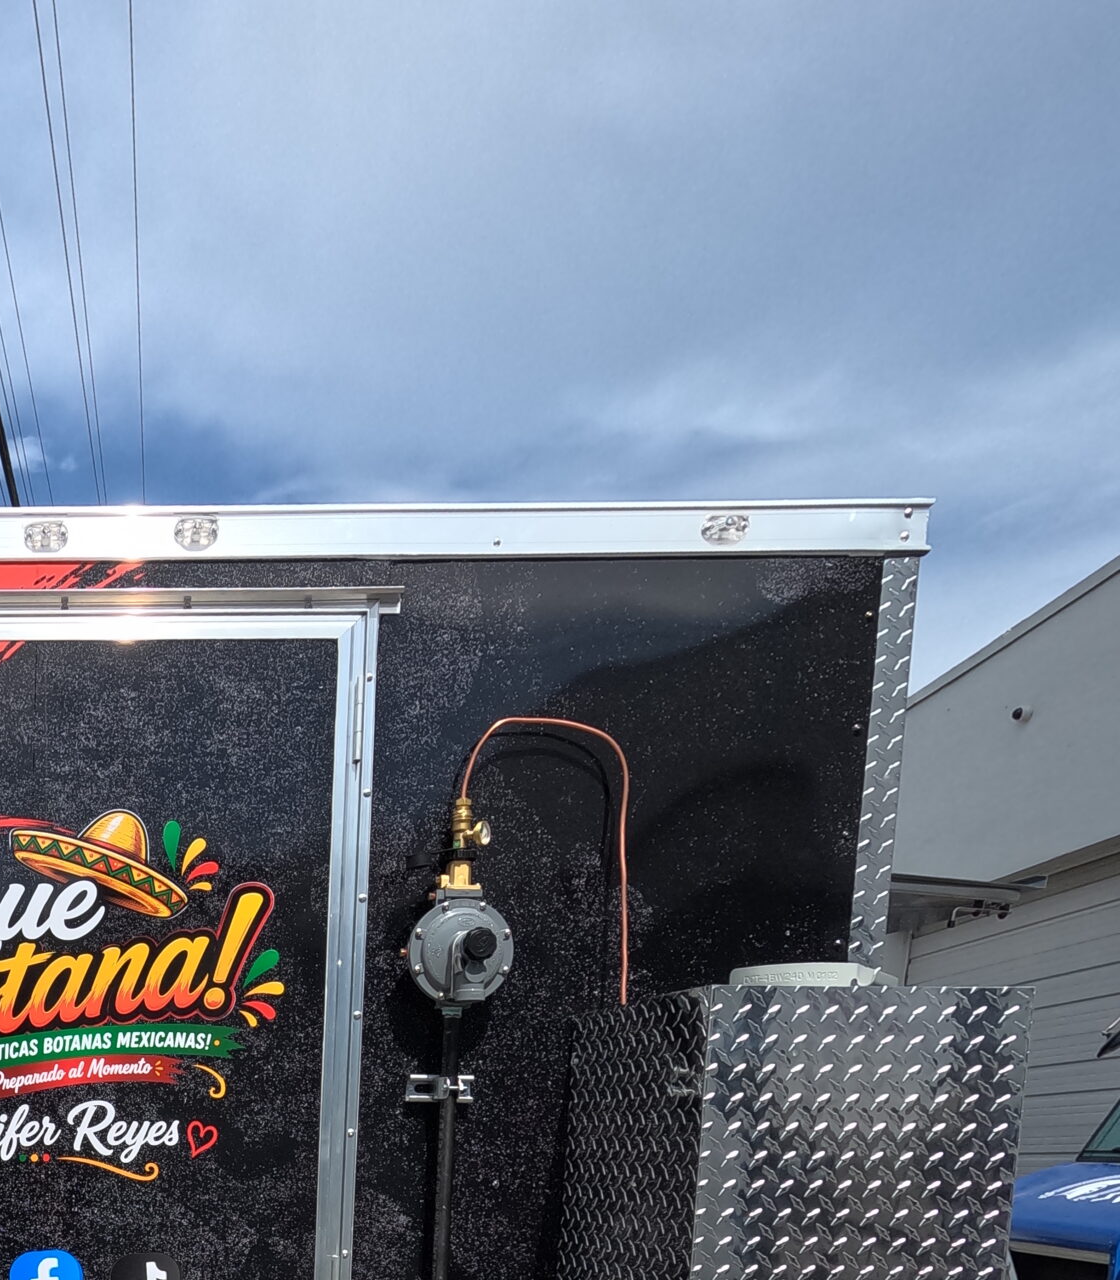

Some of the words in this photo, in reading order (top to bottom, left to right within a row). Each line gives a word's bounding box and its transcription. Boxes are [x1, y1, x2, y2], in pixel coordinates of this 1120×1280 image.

[43, 1032, 112, 1054] BOTANAS
[116, 1031, 212, 1050] MEXICANAS!
[68, 1060, 85, 1079] al
[87, 1057, 153, 1078] Momento
[66, 1099, 180, 1164] Reyes
